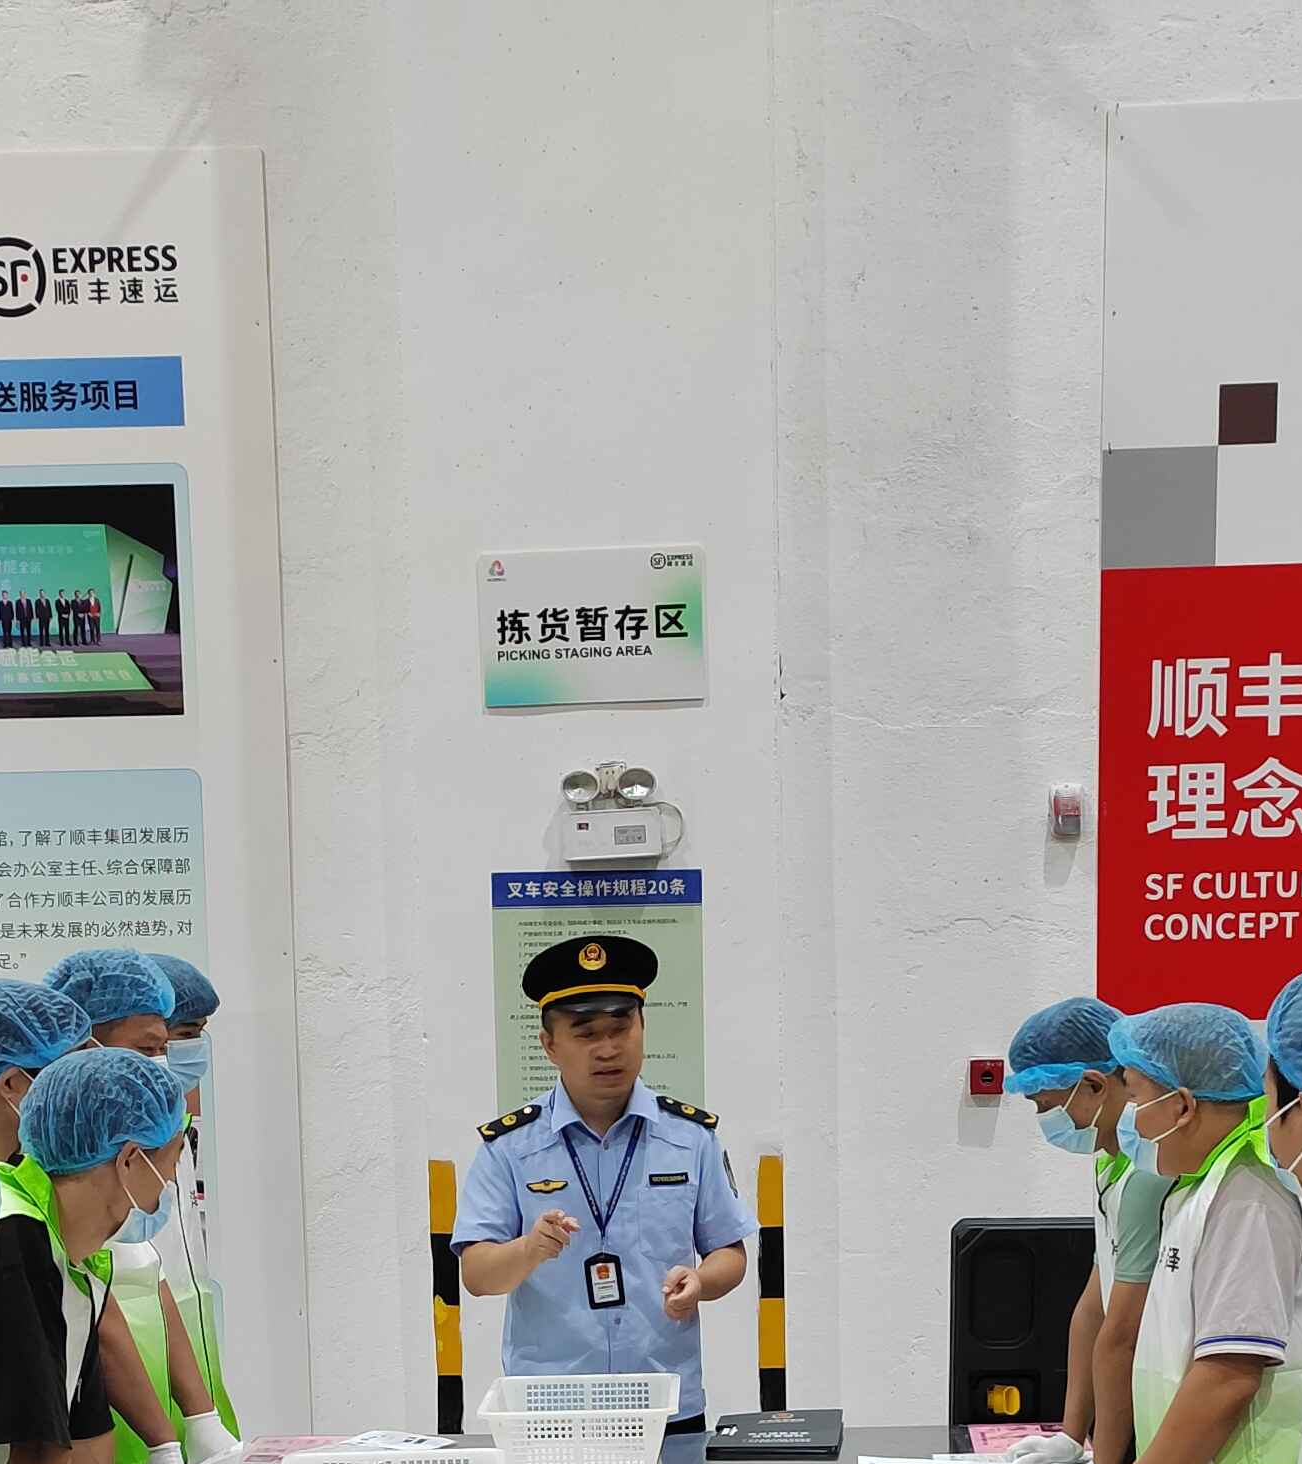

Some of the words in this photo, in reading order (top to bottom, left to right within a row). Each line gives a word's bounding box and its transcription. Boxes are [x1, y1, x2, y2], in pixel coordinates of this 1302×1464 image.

[52, 245, 178, 274] EXPRESS
[54, 277, 179, 305] 顺丰速运
[497, 604, 689, 645] 拣货暂存区
[497, 649, 551, 662] PICKING
[554, 647, 612, 660] STAGING
[615, 645, 653, 658] AREA
[507, 878, 686, 898] 叉车安全操作规程20条
[1145, 873, 1183, 900] SF
[1144, 911, 1299, 941] CONCEPT
